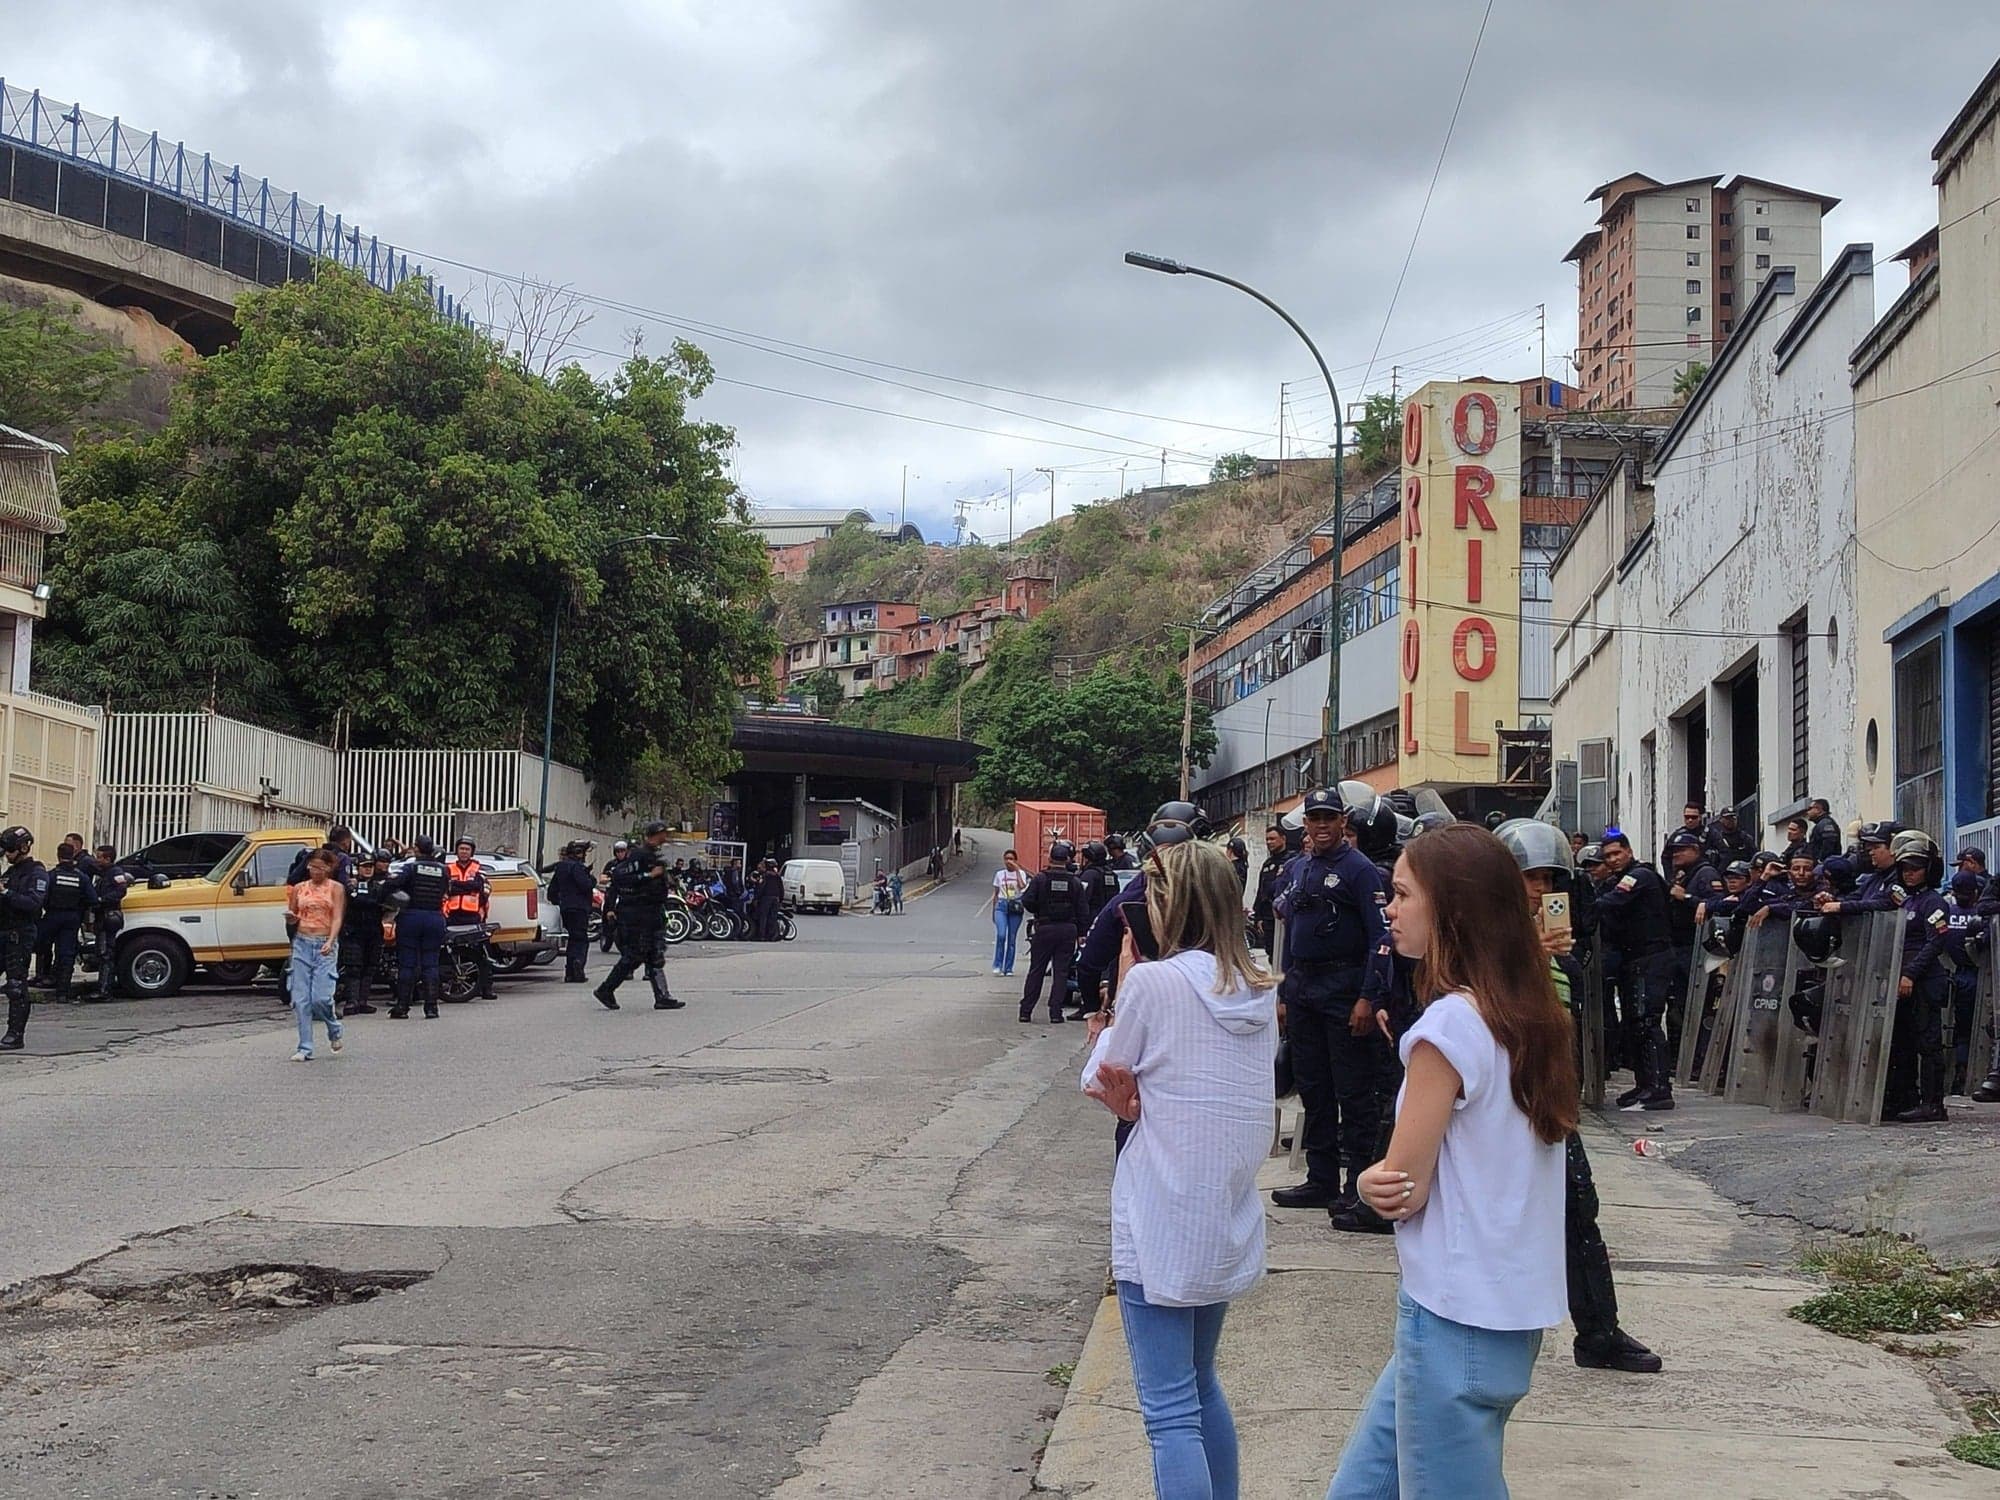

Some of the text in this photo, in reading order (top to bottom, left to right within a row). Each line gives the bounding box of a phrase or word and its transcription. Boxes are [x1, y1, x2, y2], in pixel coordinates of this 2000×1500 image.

[1403, 402, 1422, 755] ORIOL
[1453, 392, 1498, 756] ORIOL
[1754, 998, 1778, 1010] CPNB
